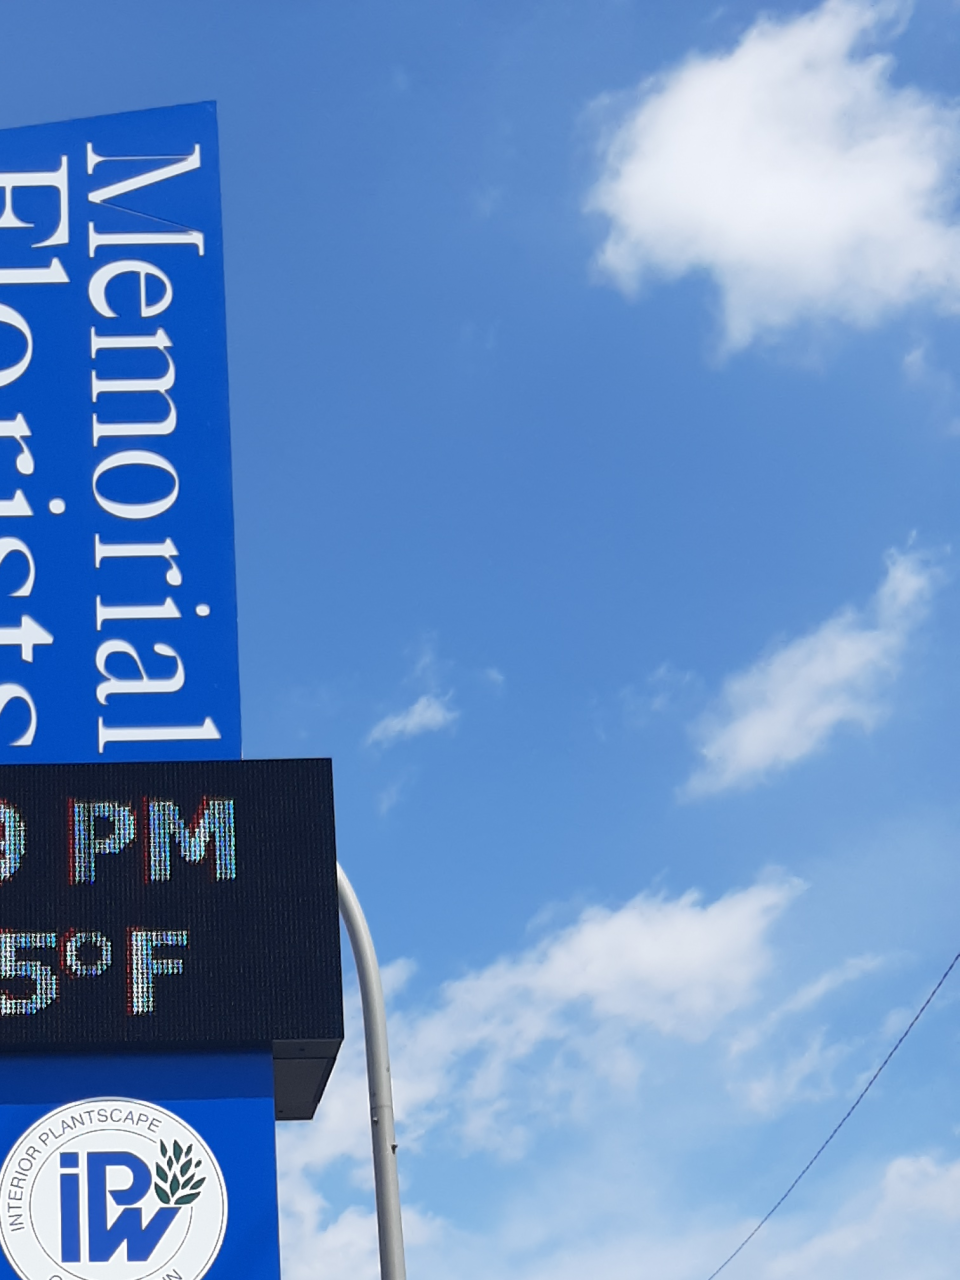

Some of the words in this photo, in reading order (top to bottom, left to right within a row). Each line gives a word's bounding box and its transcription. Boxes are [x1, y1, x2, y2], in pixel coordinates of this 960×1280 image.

[86, 142, 222, 754] Memorial
[67, 796, 237, 885] PM
[7, 1145, 41, 1232] INTERIOR
[38, 1108, 162, 1146] PLANTSCAPE
